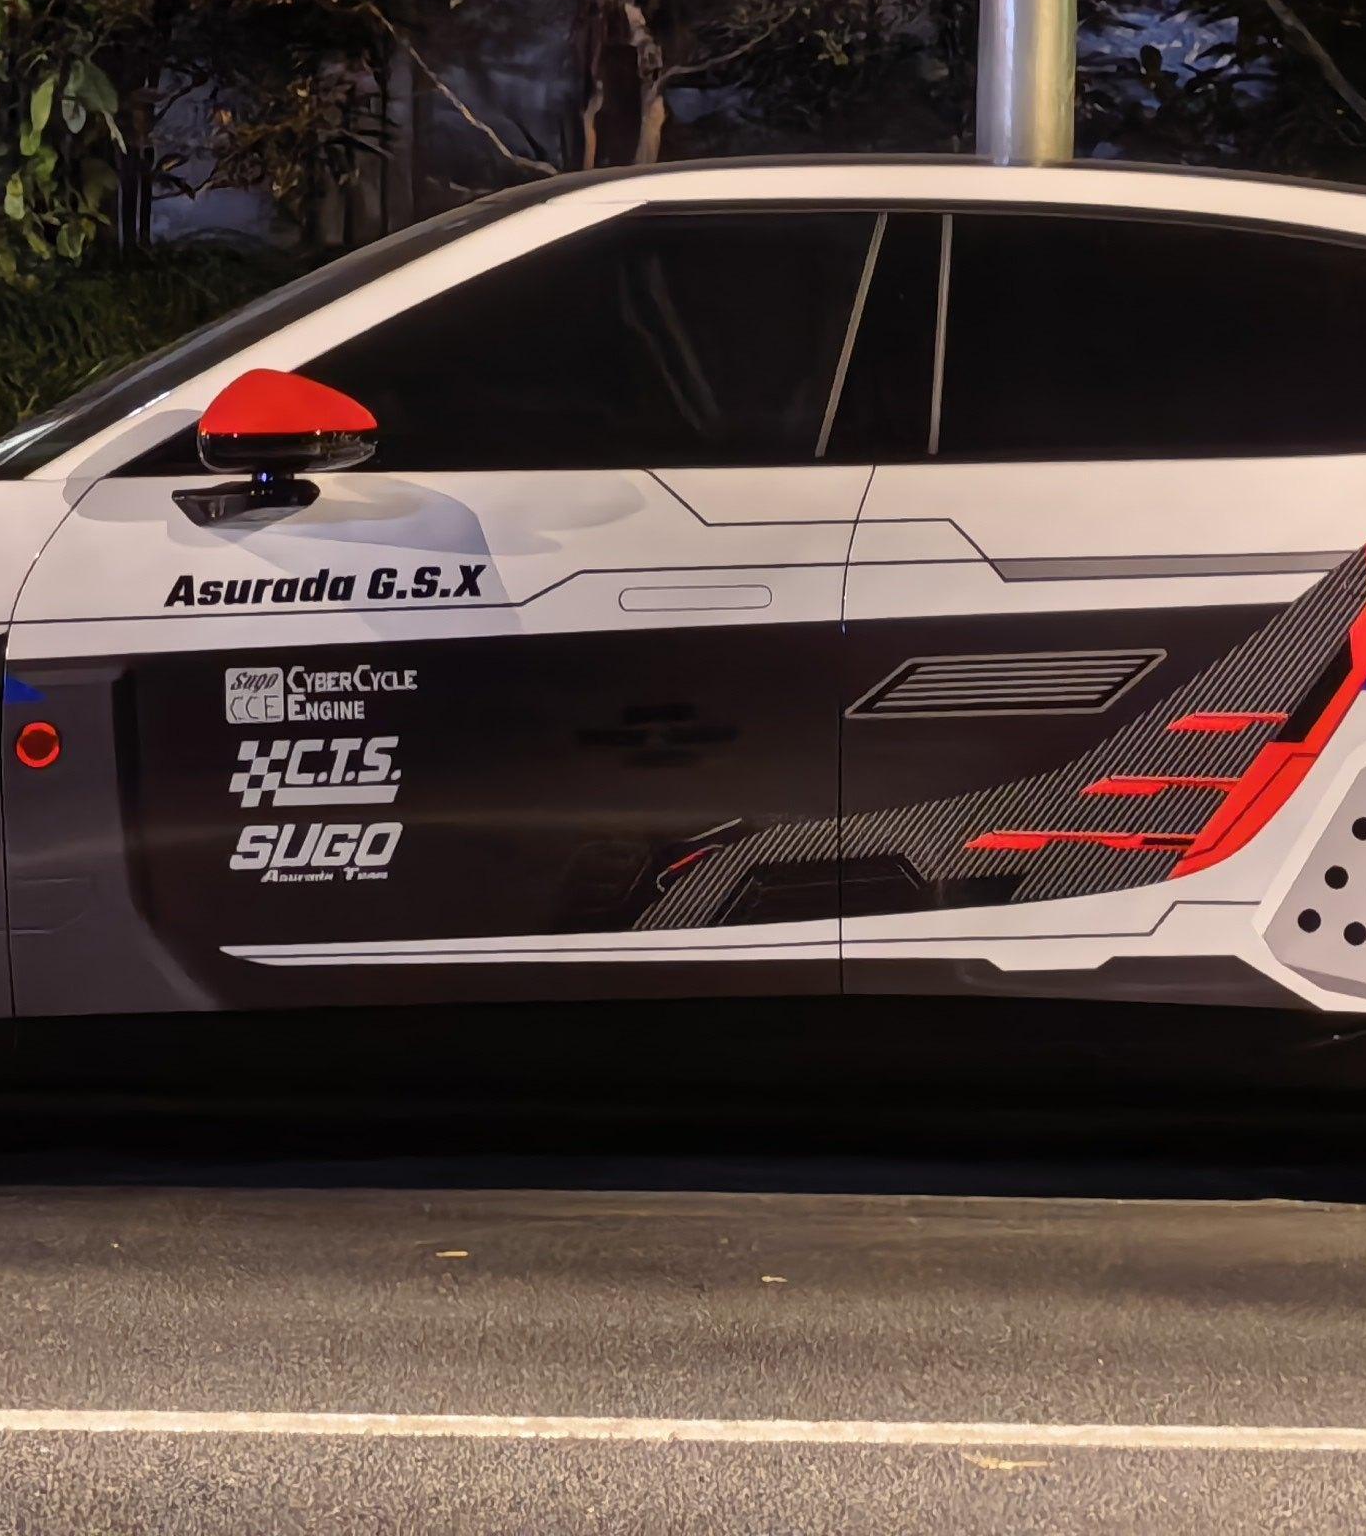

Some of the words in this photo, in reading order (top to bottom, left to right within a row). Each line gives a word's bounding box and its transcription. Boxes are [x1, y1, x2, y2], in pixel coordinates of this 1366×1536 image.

[163, 568, 356, 608] Asurada
[367, 564, 487, 600] G.S.X
[229, 694, 281, 722] CCE
[229, 821, 404, 870] SUGO
